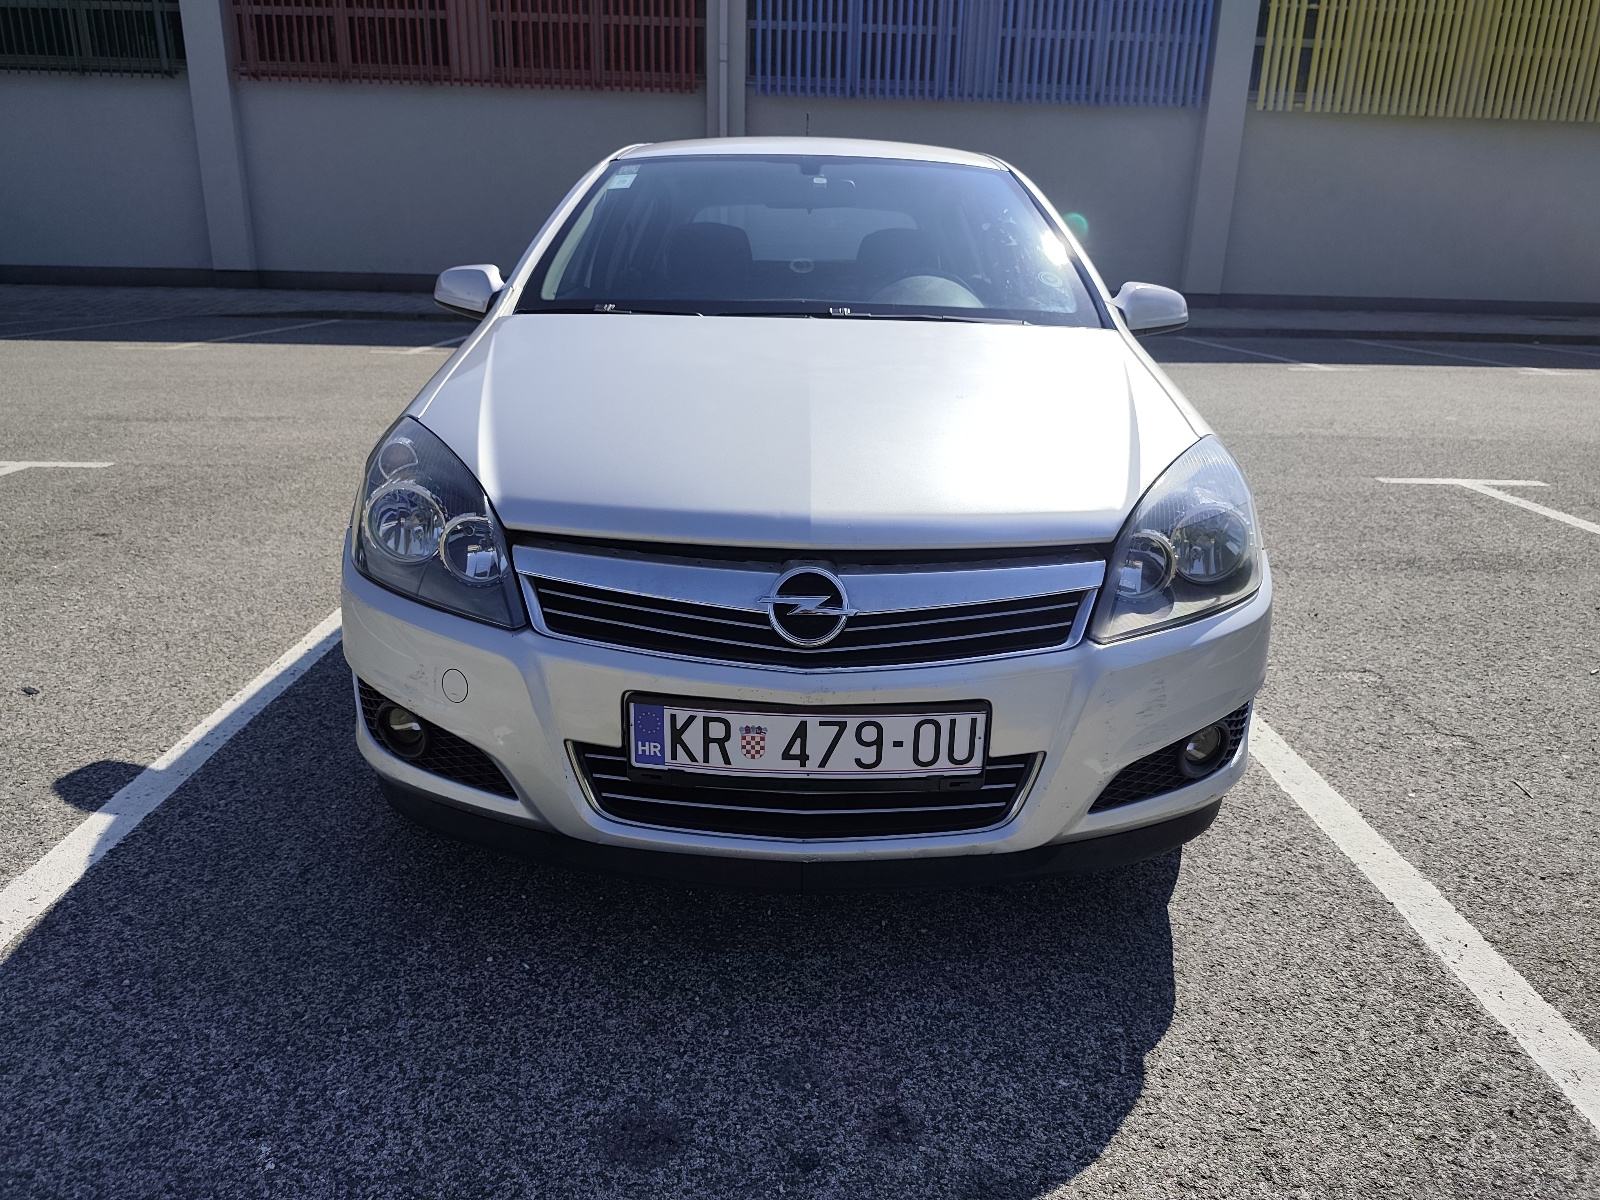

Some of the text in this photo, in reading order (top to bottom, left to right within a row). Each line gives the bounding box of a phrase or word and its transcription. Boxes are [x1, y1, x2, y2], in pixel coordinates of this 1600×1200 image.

[637, 741, 661, 757] HR
[669, 713, 977, 770] KR 479-OU
